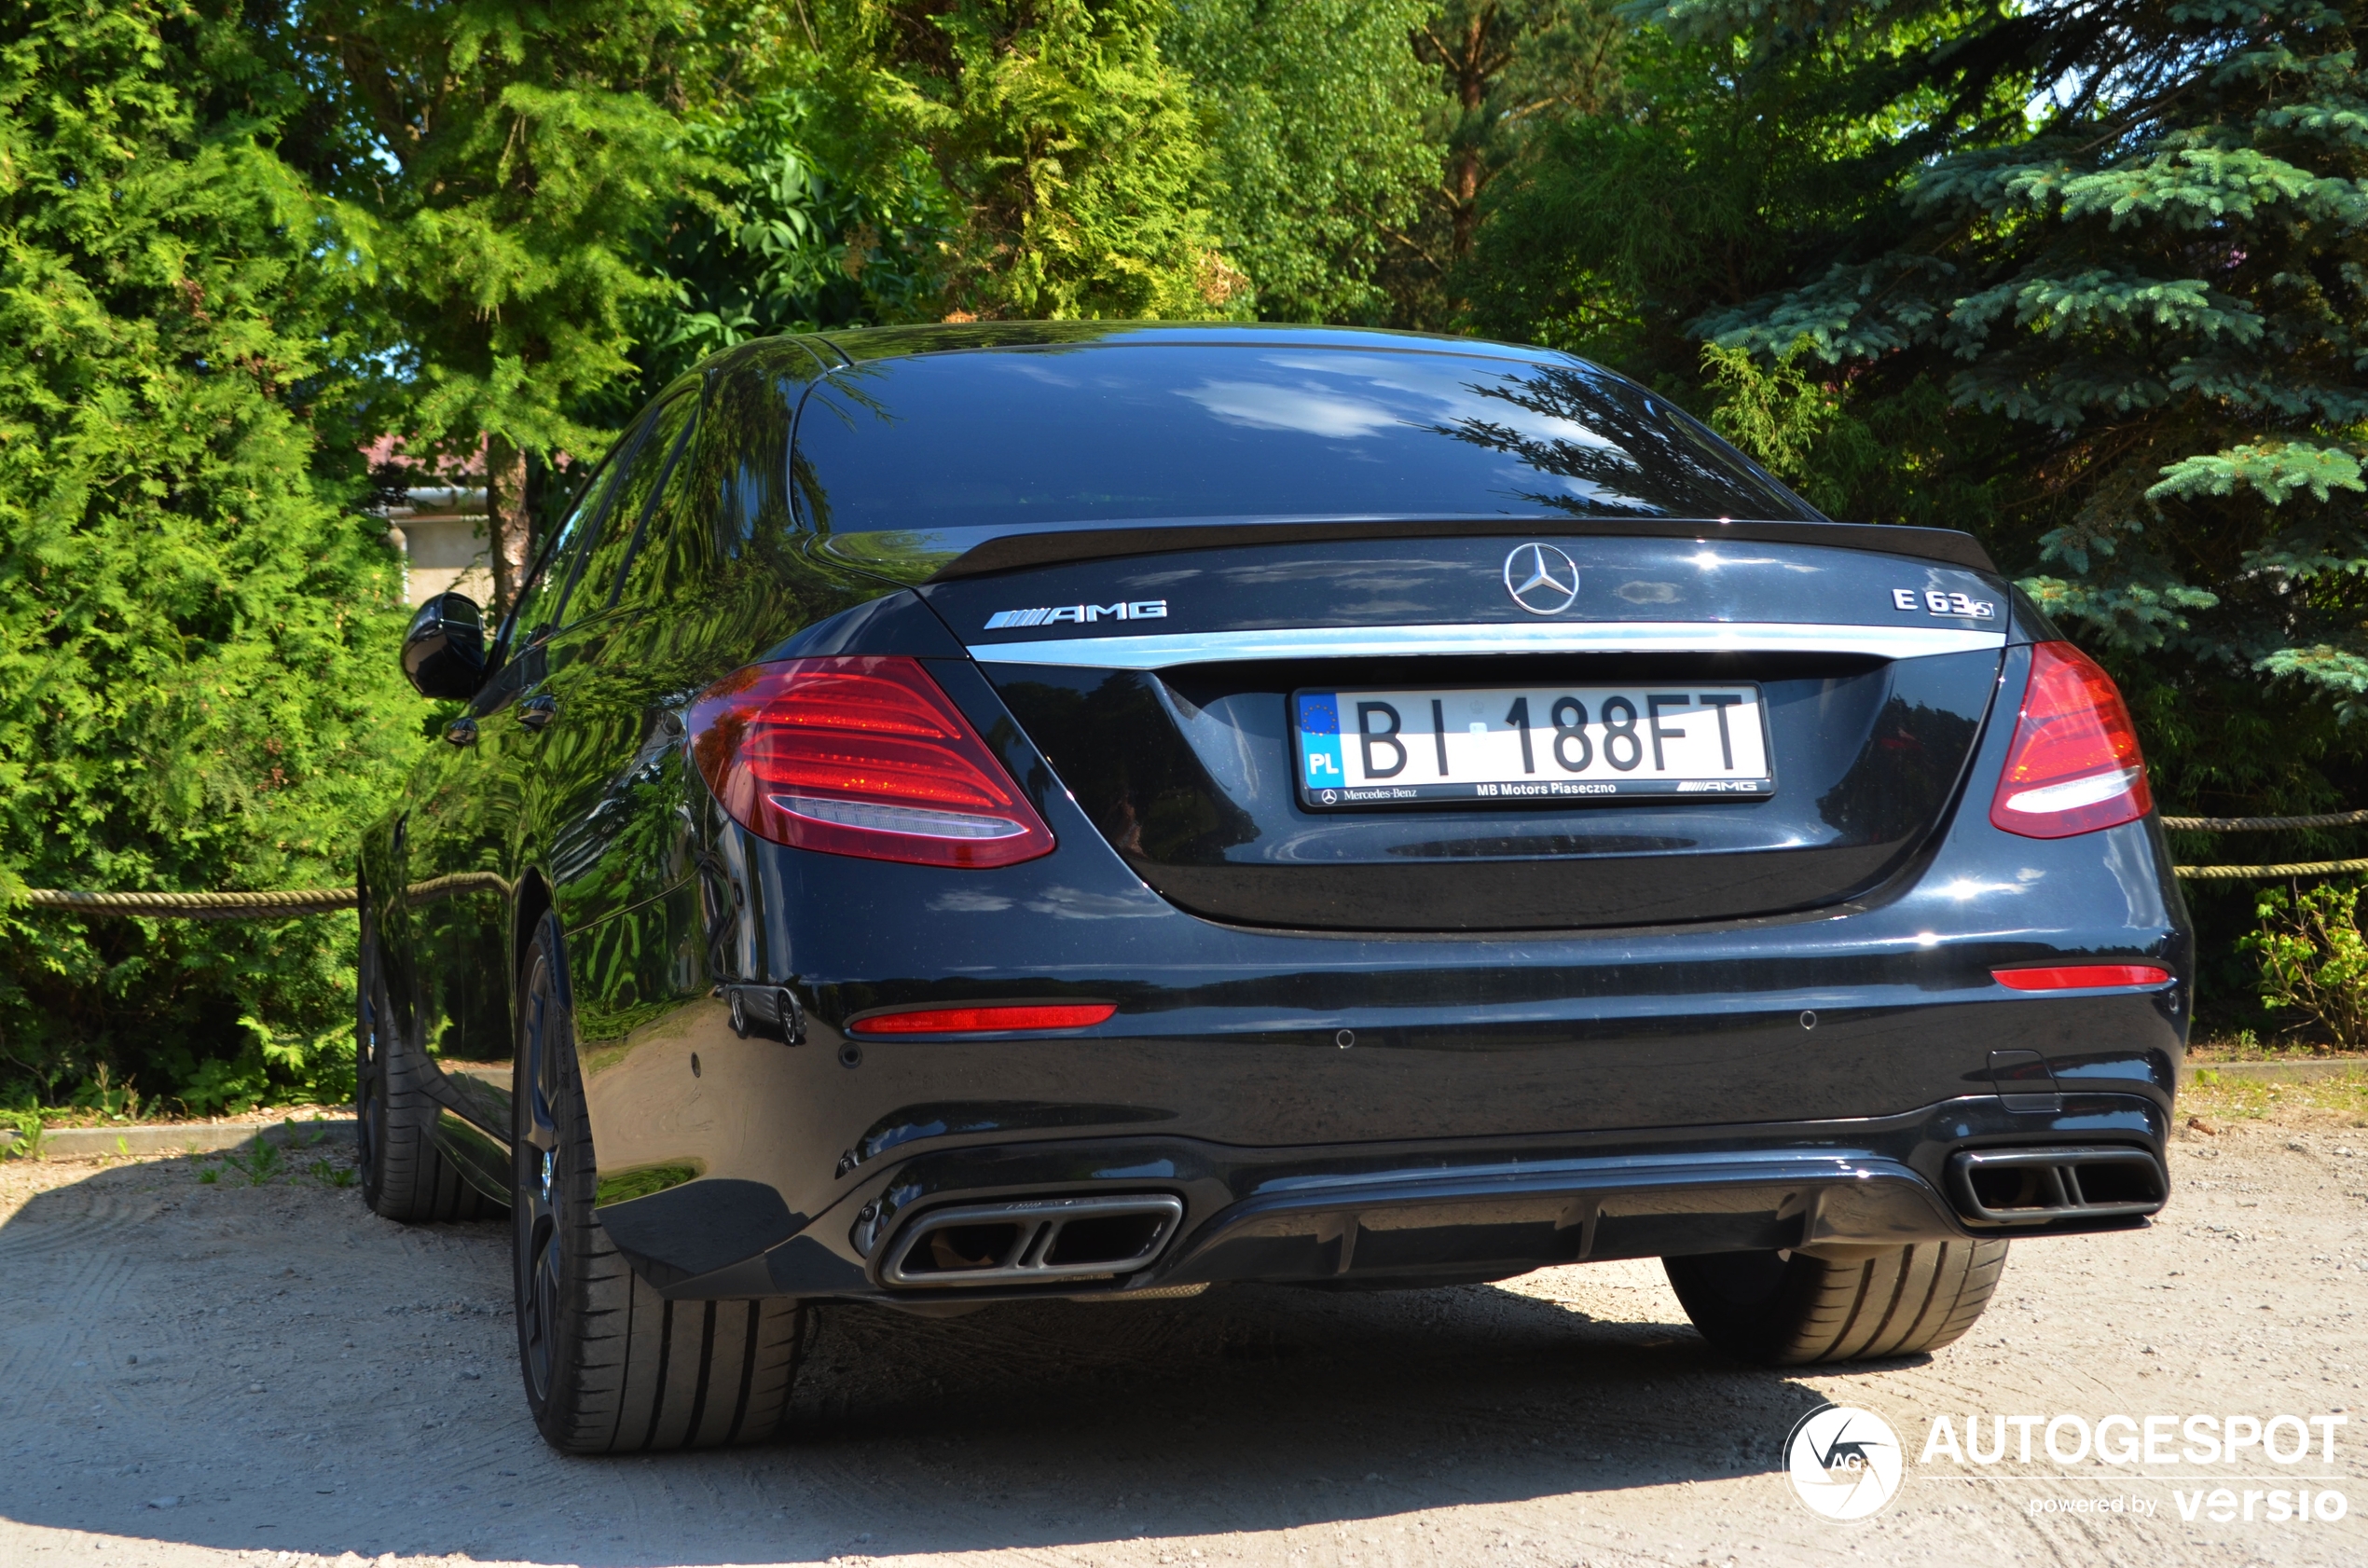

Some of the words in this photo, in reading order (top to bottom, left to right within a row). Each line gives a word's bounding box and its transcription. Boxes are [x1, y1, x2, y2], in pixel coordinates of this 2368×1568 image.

[1892, 588, 1919, 611] E
[1041, 599, 1167, 626] AMG
[1356, 698, 1450, 779] BI
[1504, 694, 1742, 773] 188FT
[1308, 752, 1340, 775] PL
[1343, 789, 1417, 800] Mercedes-Benz
[1477, 784, 1498, 796] MB
[1500, 783, 1549, 795] Motors
[1550, 782, 1617, 795] Piaseczno
[1702, 780, 1757, 791] AMG
